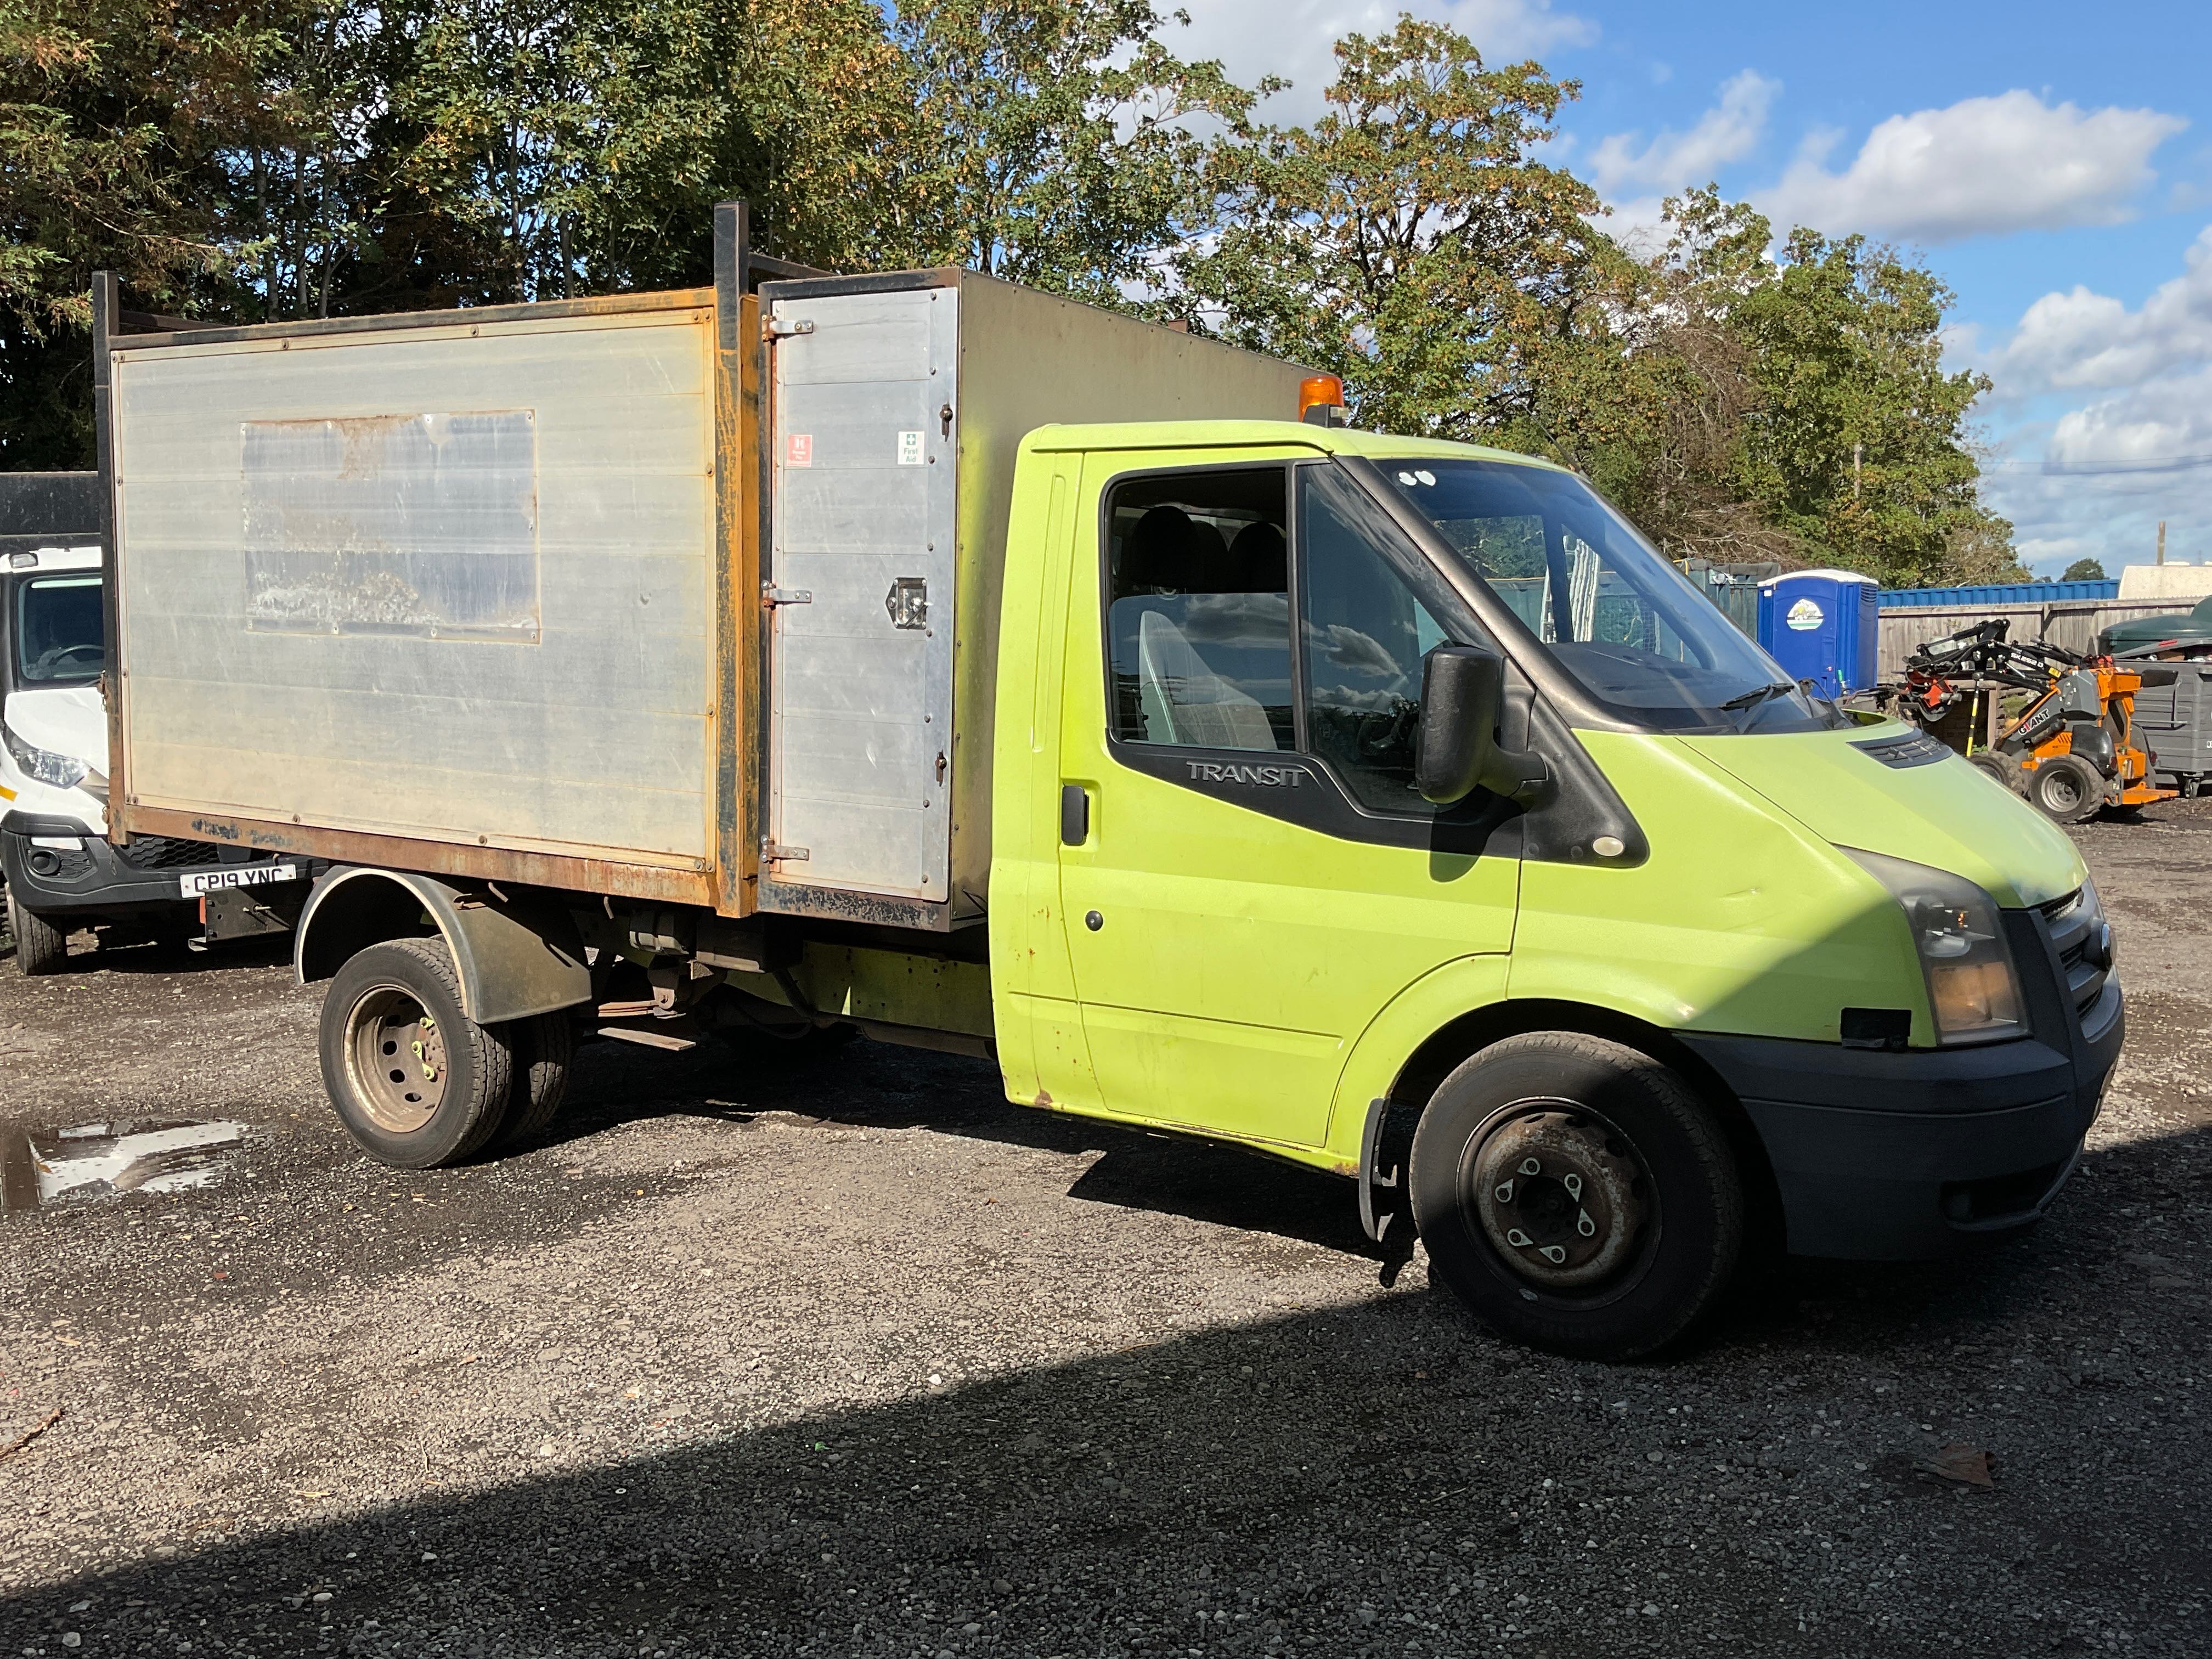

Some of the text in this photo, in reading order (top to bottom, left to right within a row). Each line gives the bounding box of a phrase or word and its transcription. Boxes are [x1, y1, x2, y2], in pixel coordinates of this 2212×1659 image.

[2018, 708, 2050, 735] GIANT
[1186, 760, 1306, 788] TRANSIT
[194, 872, 239, 892] CP19
